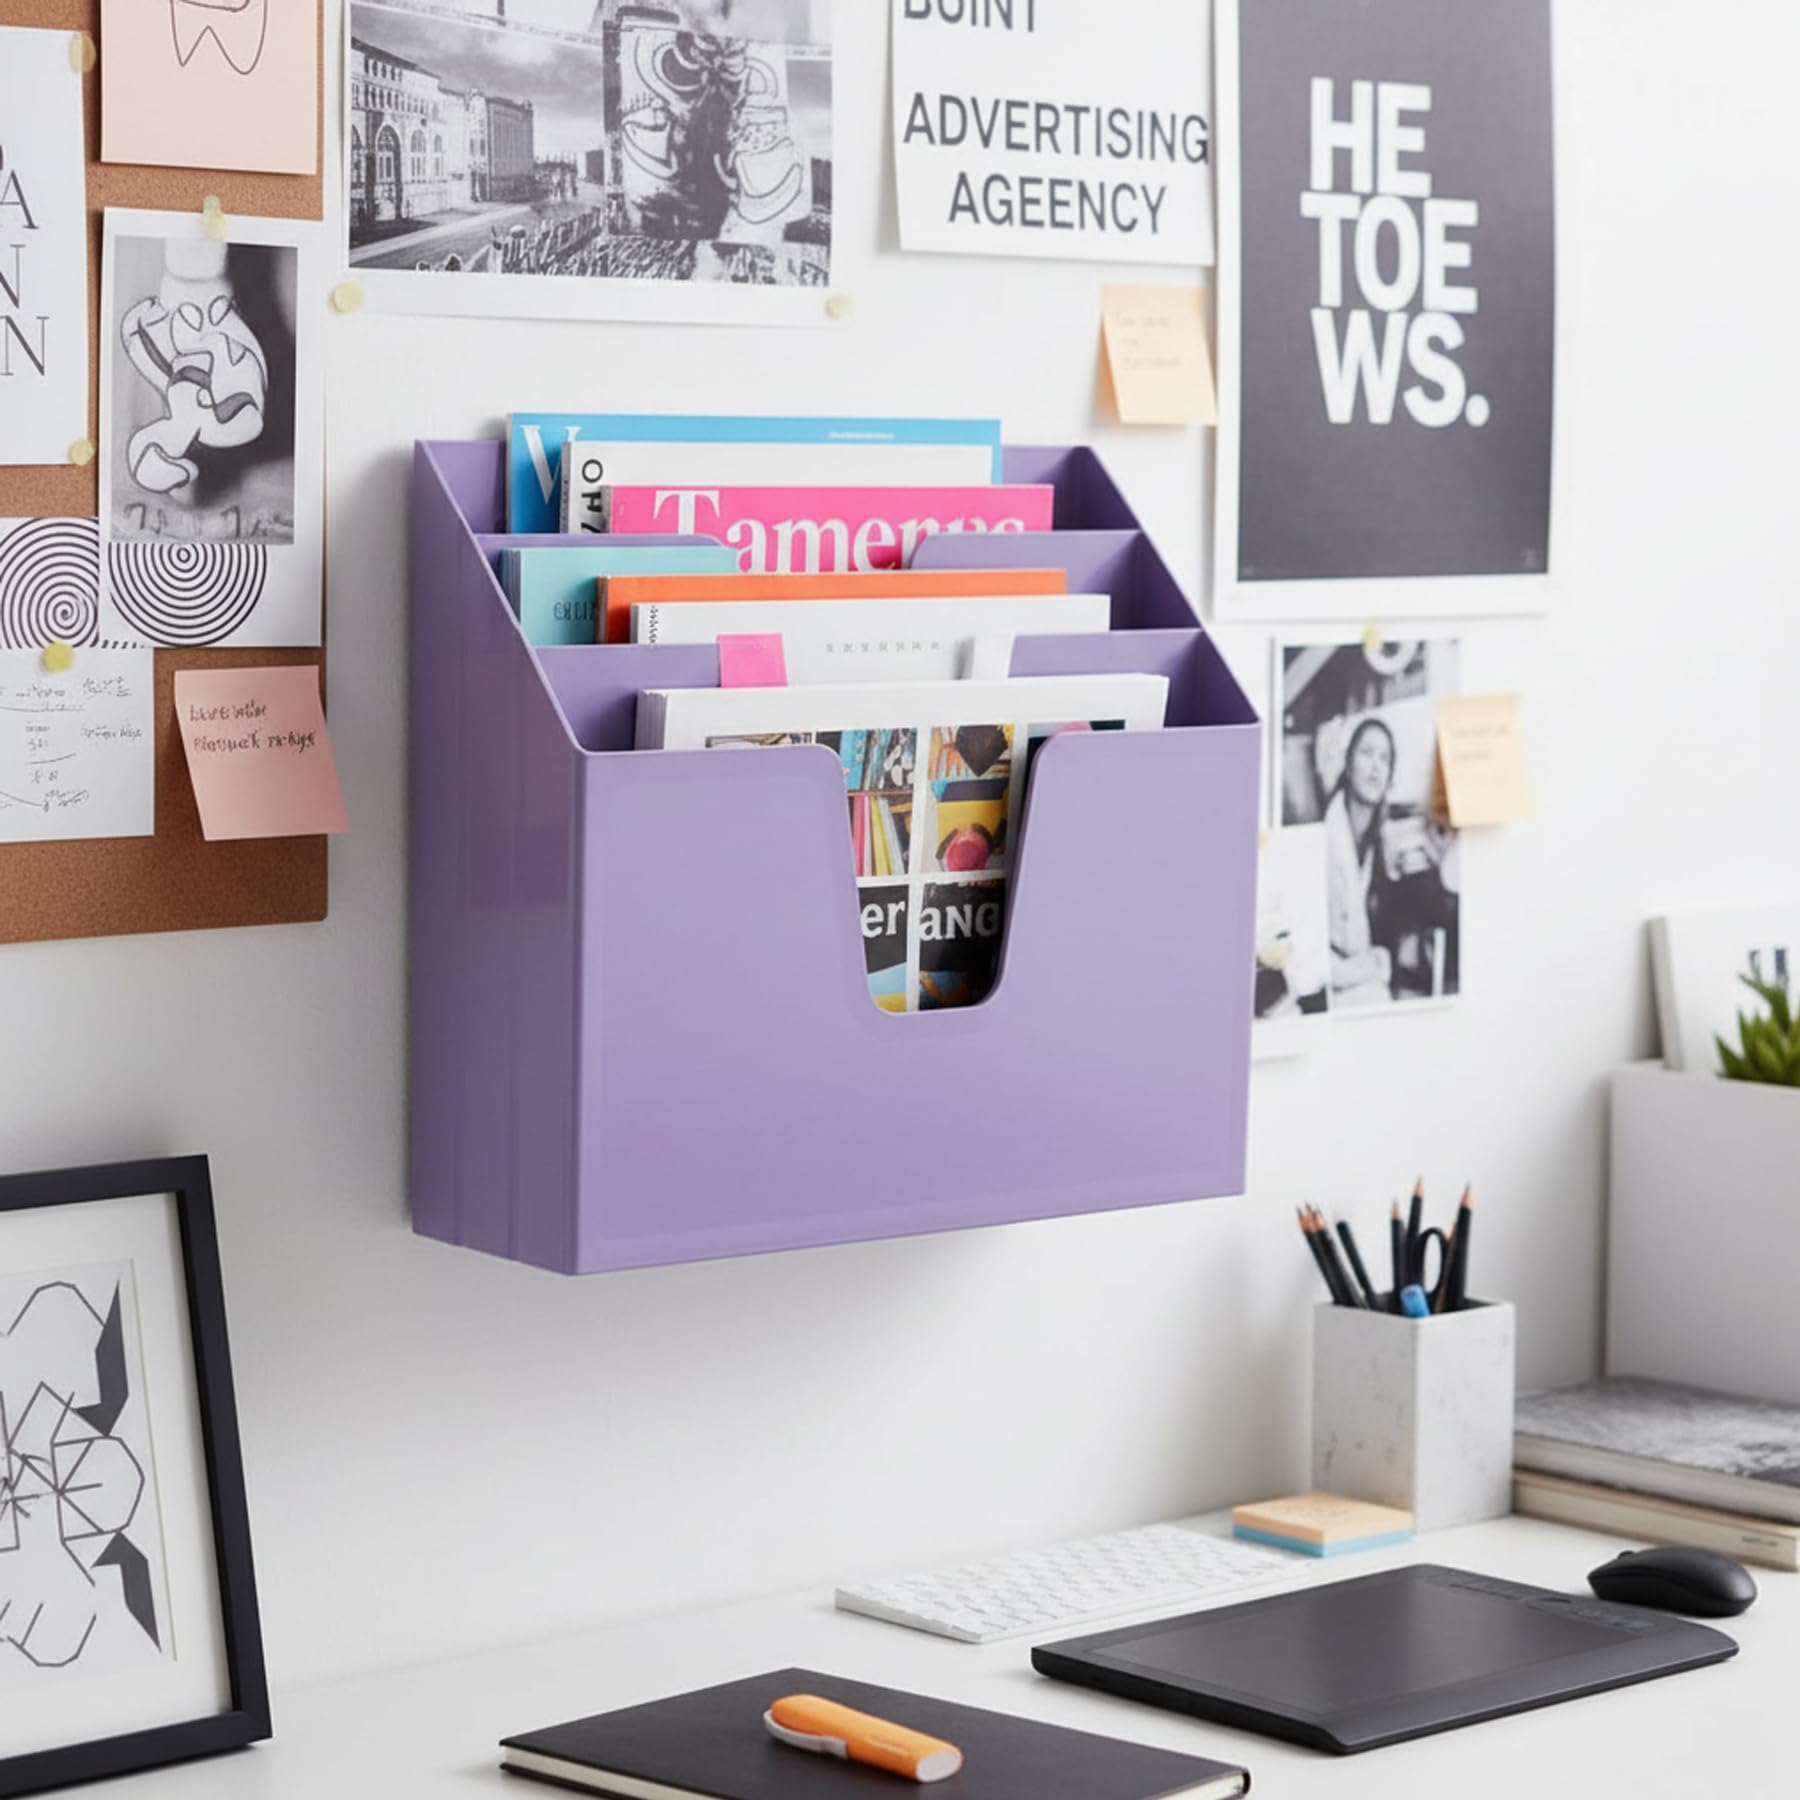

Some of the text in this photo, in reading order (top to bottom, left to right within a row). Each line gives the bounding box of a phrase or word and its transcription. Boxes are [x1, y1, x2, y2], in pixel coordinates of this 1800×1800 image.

[903, 92, 1209, 165] ADVERTISING
[1311, 77, 1431, 197] HE
[948, 172, 1167, 234] AGEENCY
[1300, 191, 1478, 313] TOE
[1310, 307, 1490, 428] WS.
